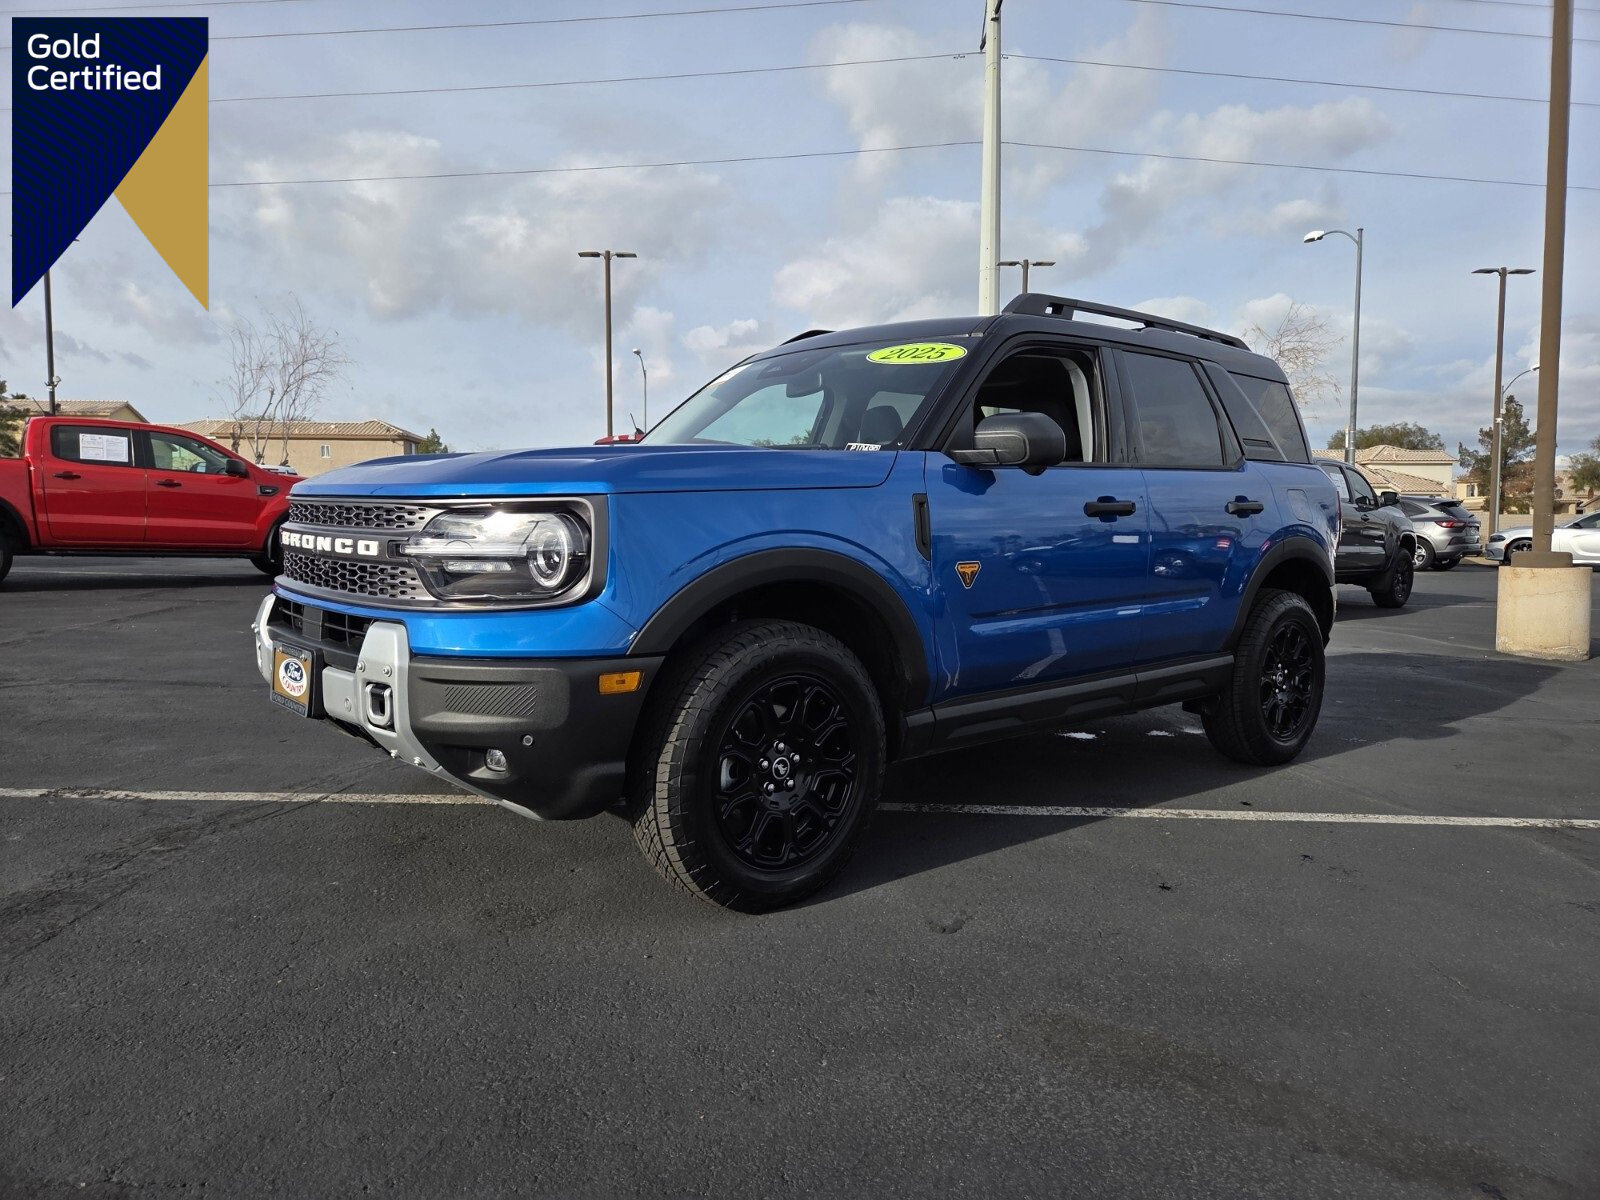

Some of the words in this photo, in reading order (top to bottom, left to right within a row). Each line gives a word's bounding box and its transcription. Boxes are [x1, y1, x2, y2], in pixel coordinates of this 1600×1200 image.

[879, 346, 953, 361] 2025
[281, 530, 379, 556] BRONCO
[287, 662, 302, 681] Ford
[282, 675, 304, 693] COUNTRY
